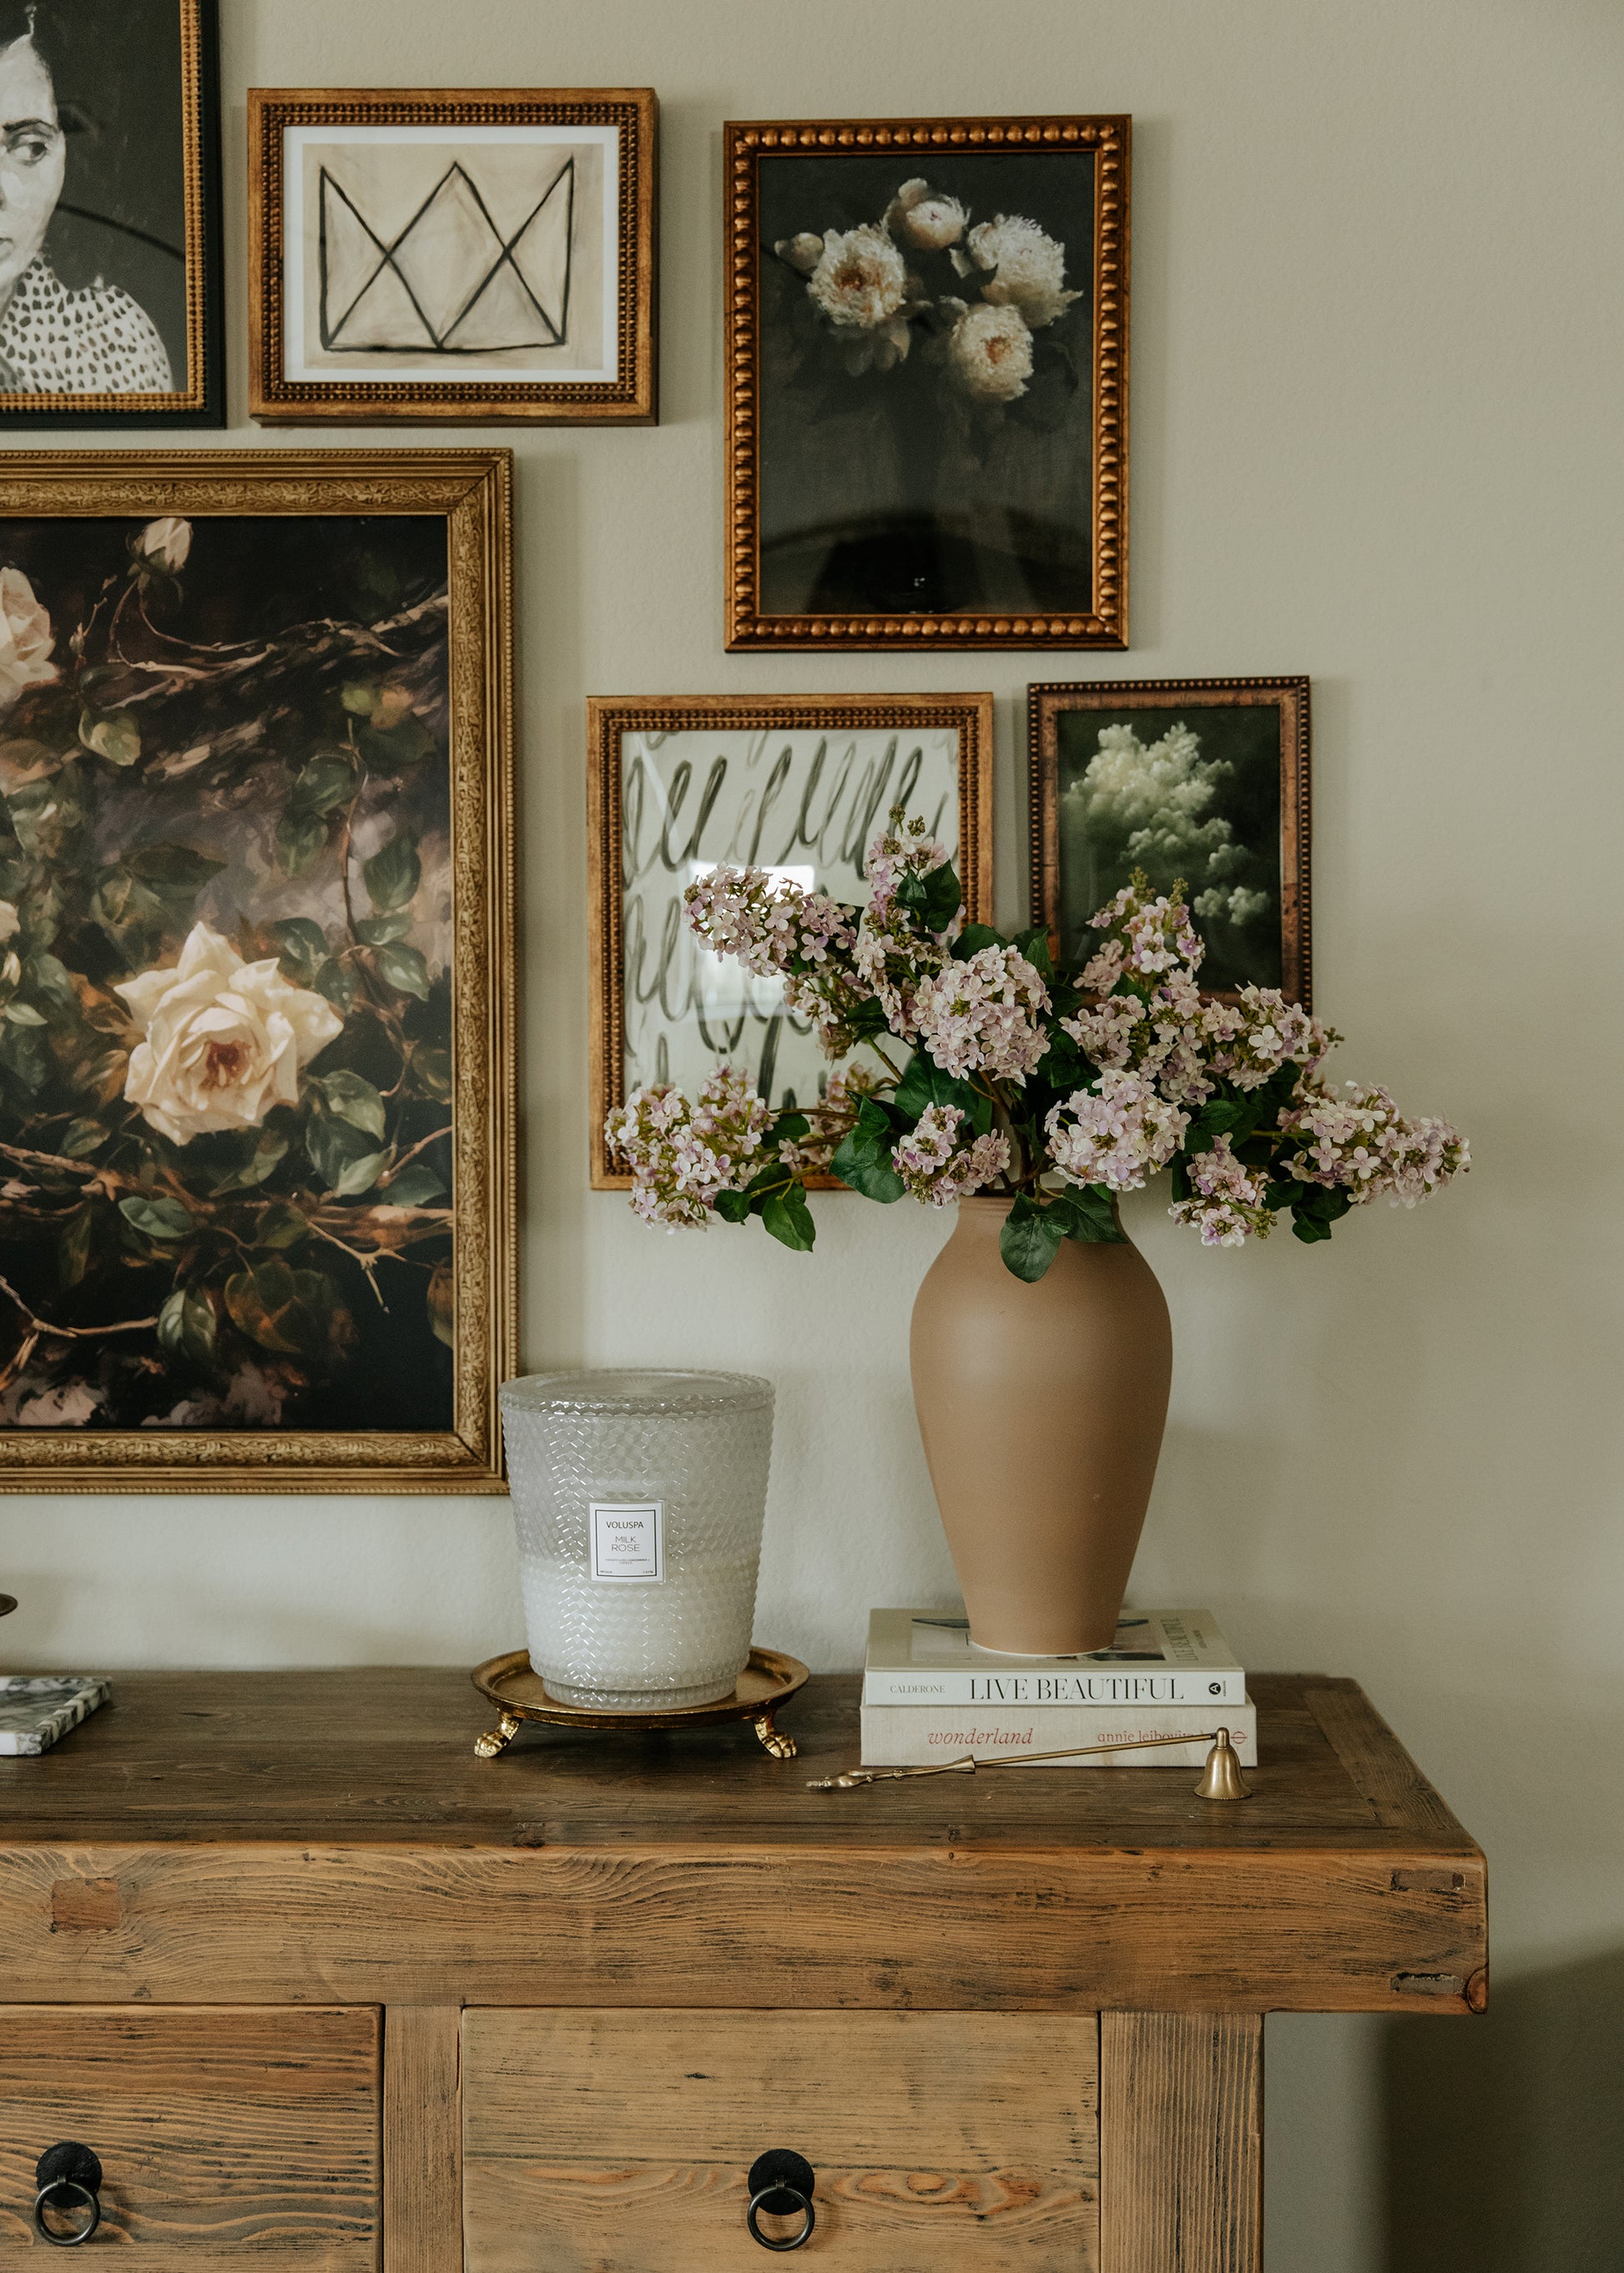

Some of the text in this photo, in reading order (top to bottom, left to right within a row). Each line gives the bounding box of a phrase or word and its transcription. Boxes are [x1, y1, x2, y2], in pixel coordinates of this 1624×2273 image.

[890, 1685, 946, 1694] CALDERONE
[969, 1678, 1184, 1700] LIVE BEAUTIFUL
[1209, 1683, 1219, 1694] A
[928, 1728, 1033, 1745] wonderland
[1097, 1731, 1135, 1742] annie
